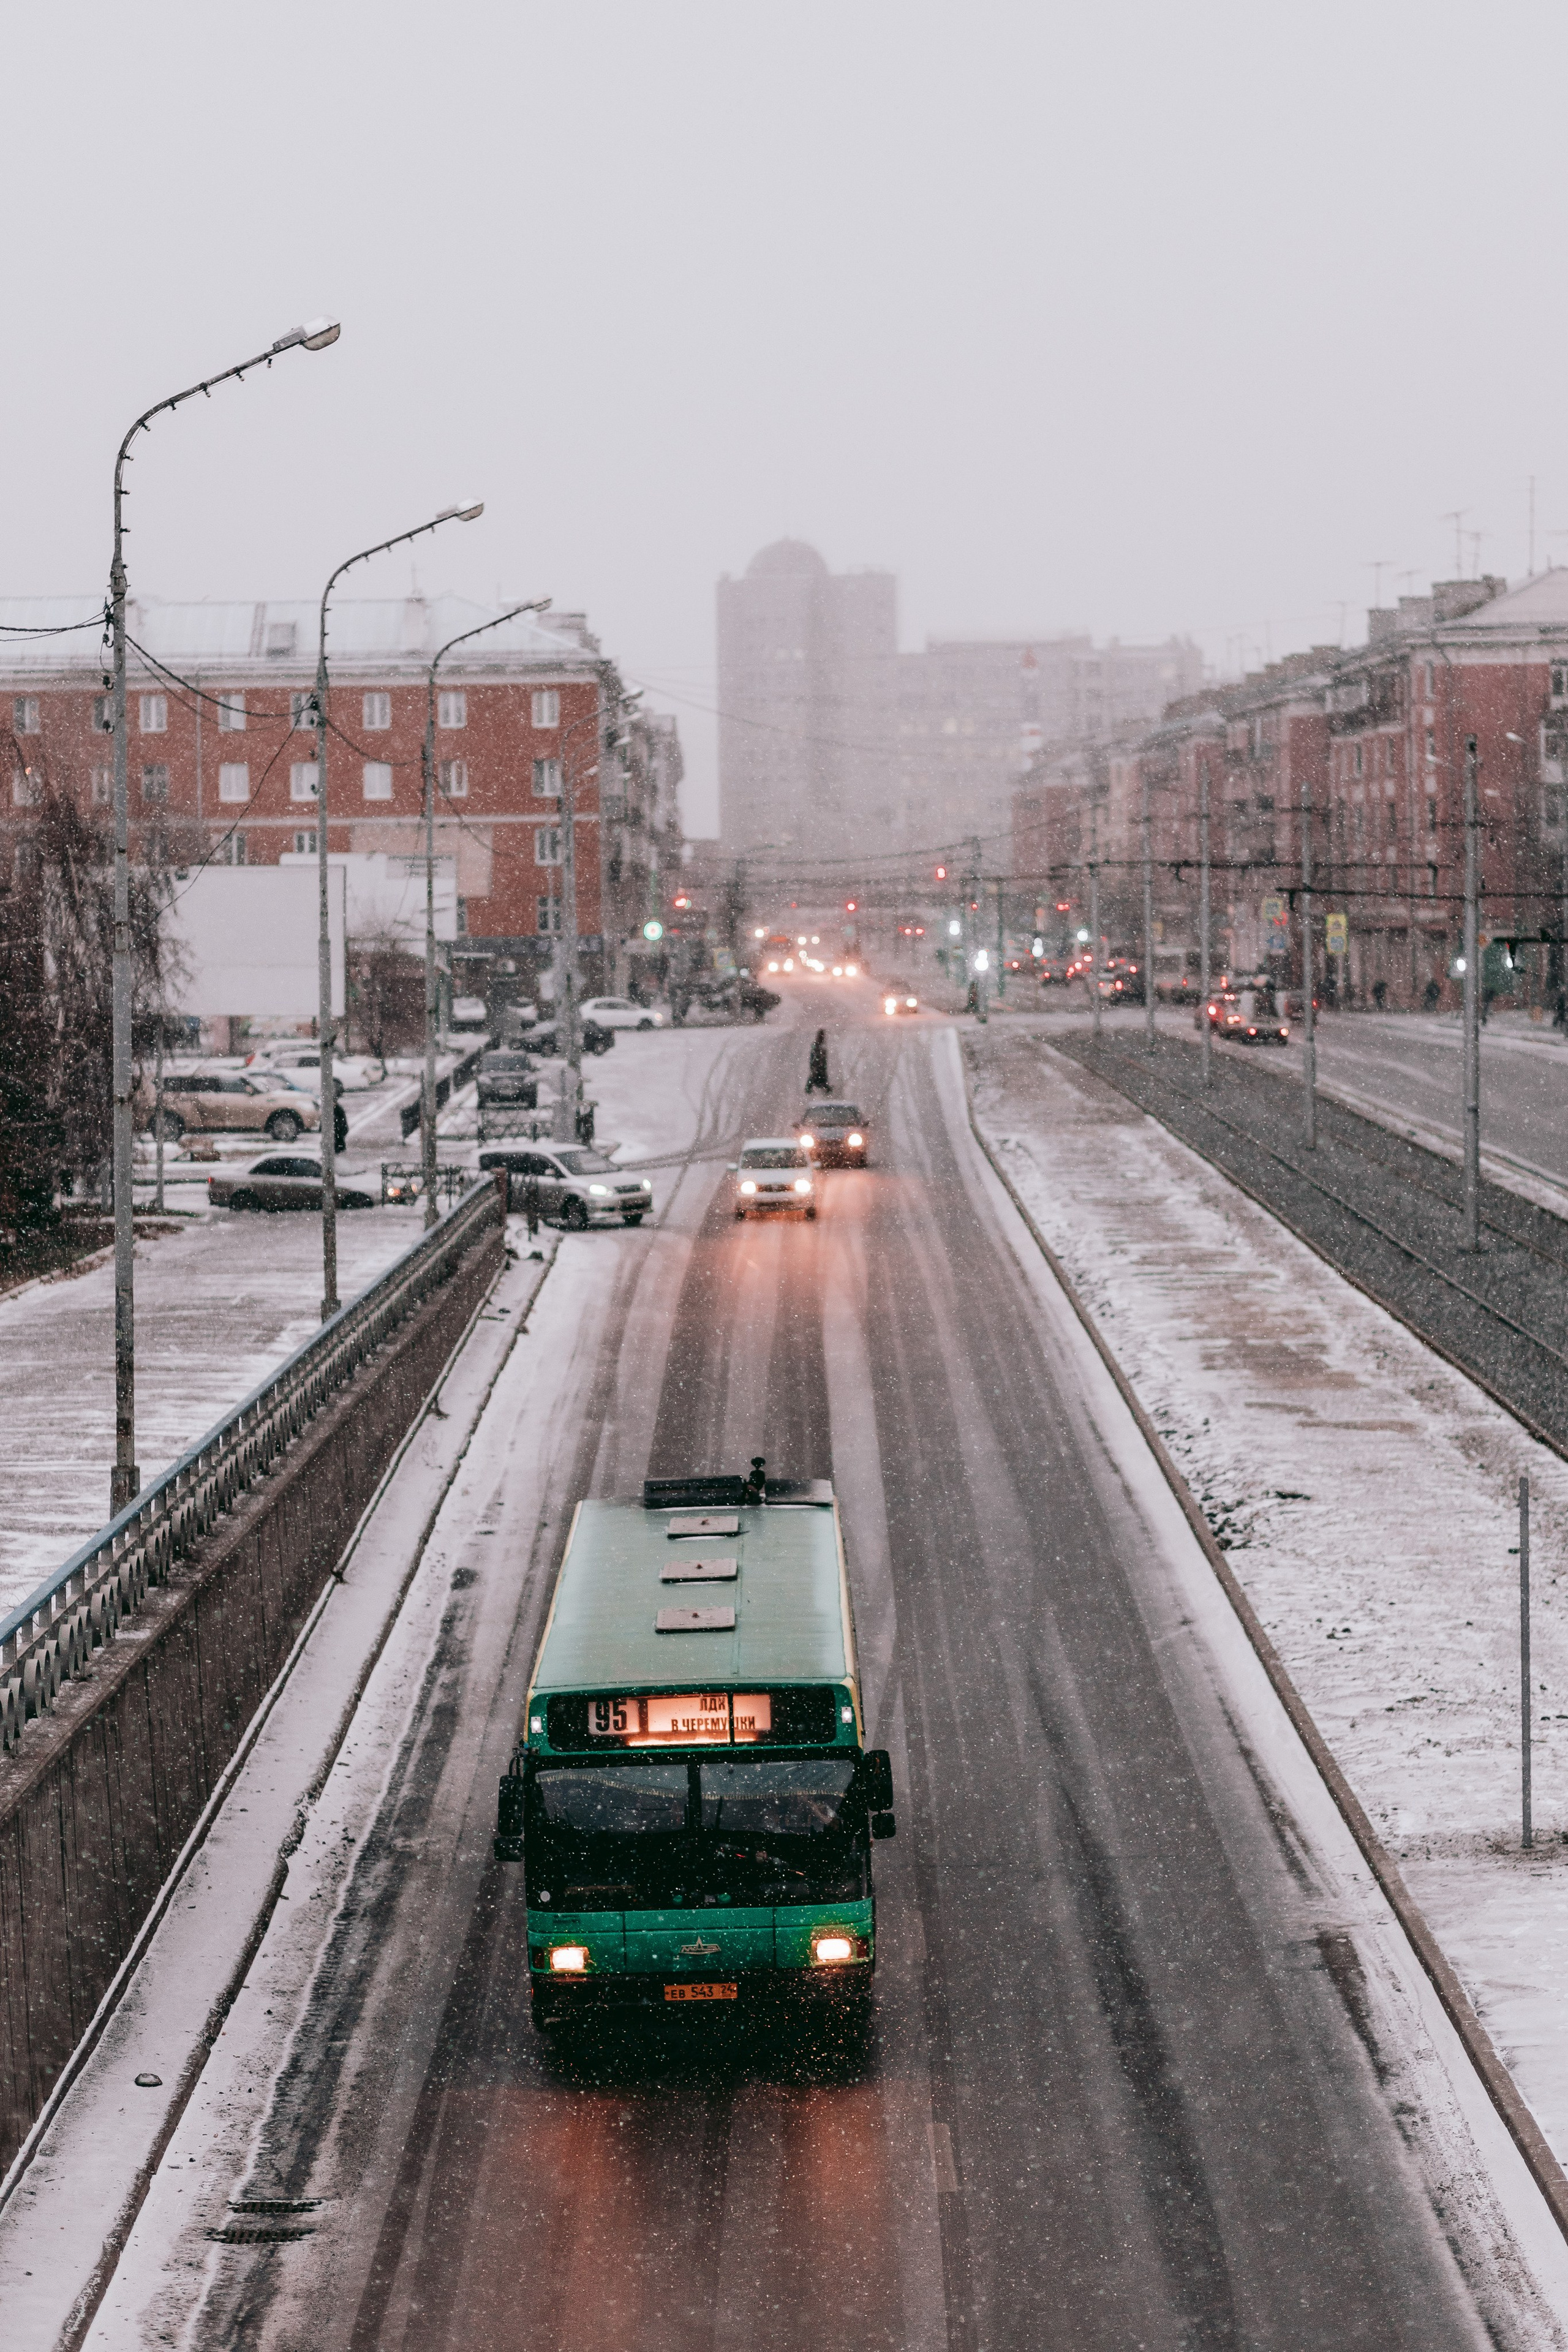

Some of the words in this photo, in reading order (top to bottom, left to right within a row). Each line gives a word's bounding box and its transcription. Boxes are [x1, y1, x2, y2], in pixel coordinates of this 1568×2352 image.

[595, 1699, 627, 1732] 95
[691, 1985, 714, 1998] 543
[720, 1985, 733, 1994] 24
